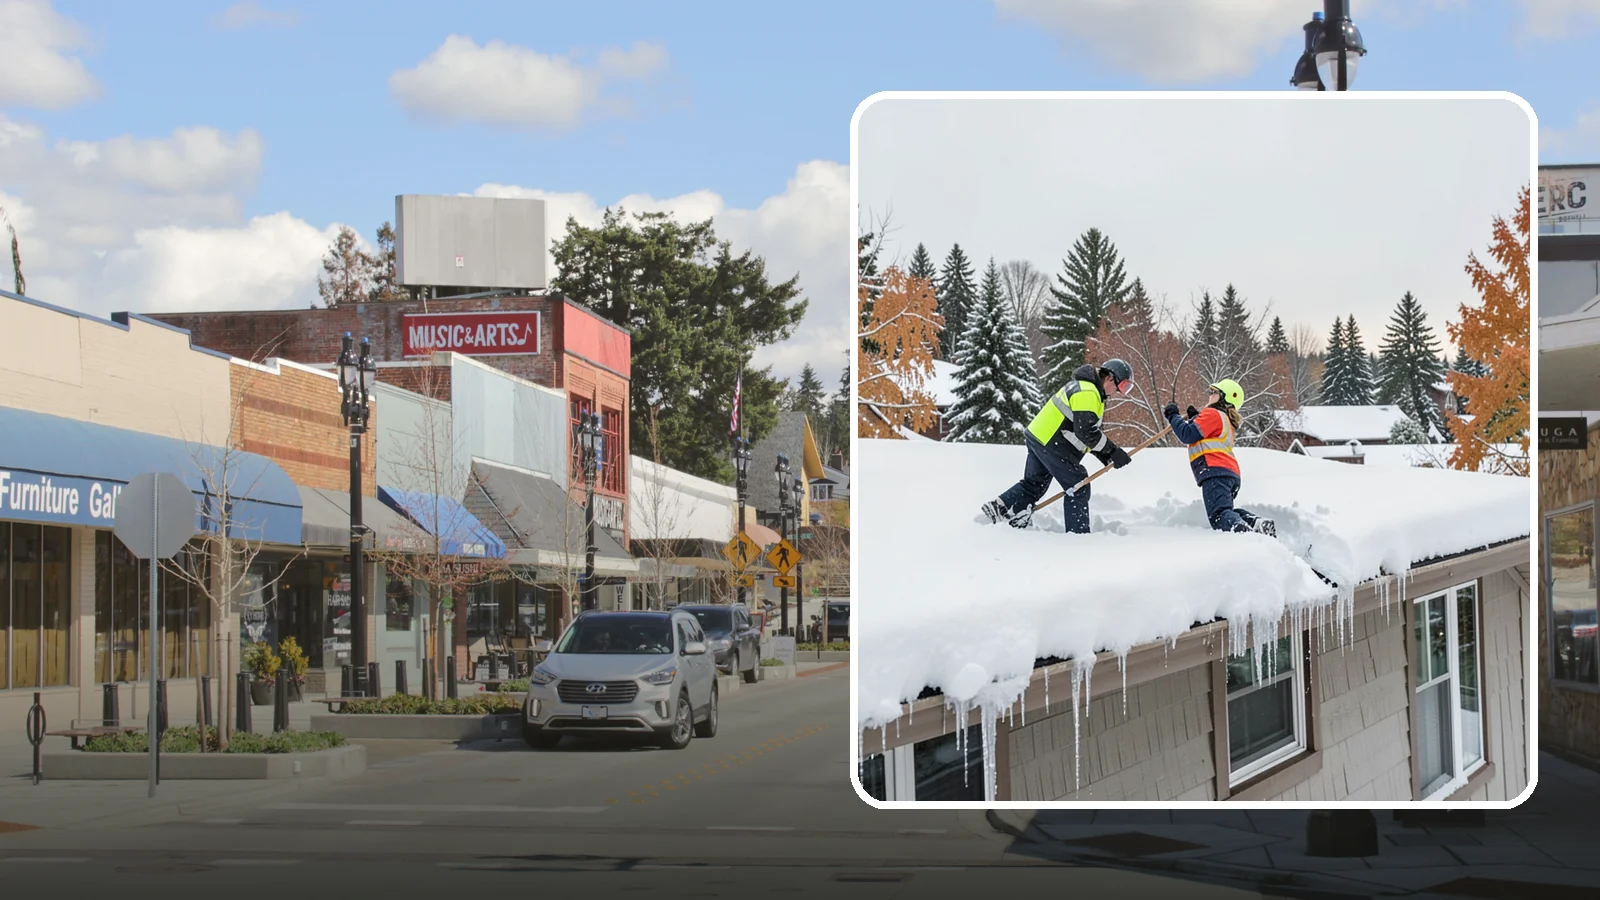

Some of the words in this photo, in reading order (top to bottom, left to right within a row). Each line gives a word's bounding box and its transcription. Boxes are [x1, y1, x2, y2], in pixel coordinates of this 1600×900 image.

[1540, 427, 1578, 437] UGA
[0, 472, 79, 515] Furniture
[453, 563, 480, 574] SUSHI
